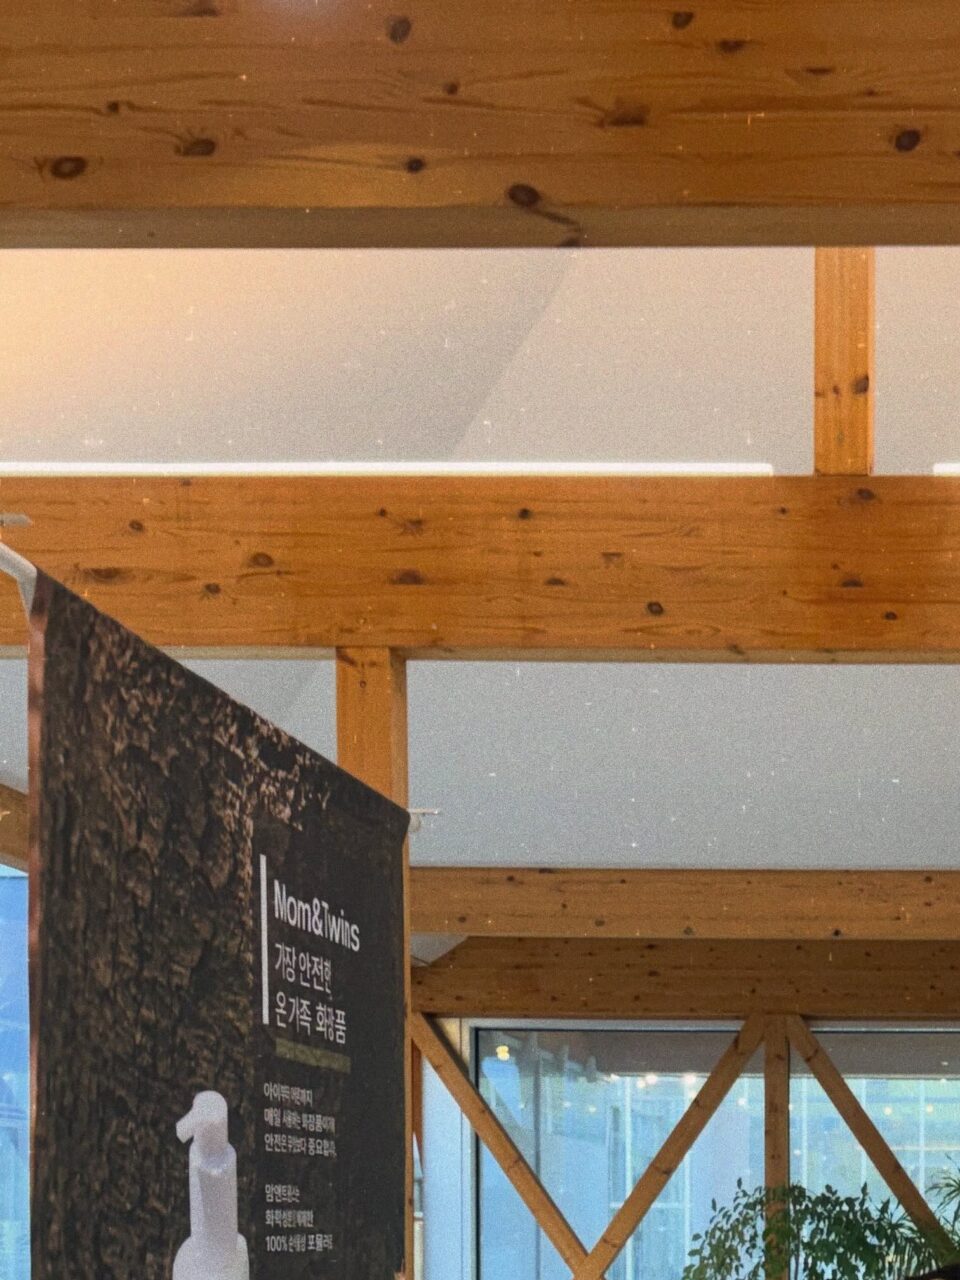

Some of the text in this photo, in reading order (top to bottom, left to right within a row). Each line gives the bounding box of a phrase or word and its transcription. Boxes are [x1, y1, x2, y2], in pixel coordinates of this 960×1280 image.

[273, 879, 360, 952] Mom&Twins
[275, 942, 333, 994] 가장 안전한
[315, 1002, 347, 1045] 화장품
[263, 1107, 281, 1127] 매일
[264, 1132, 287, 1153] 안전은
[265, 1235, 287, 1252] 100%
